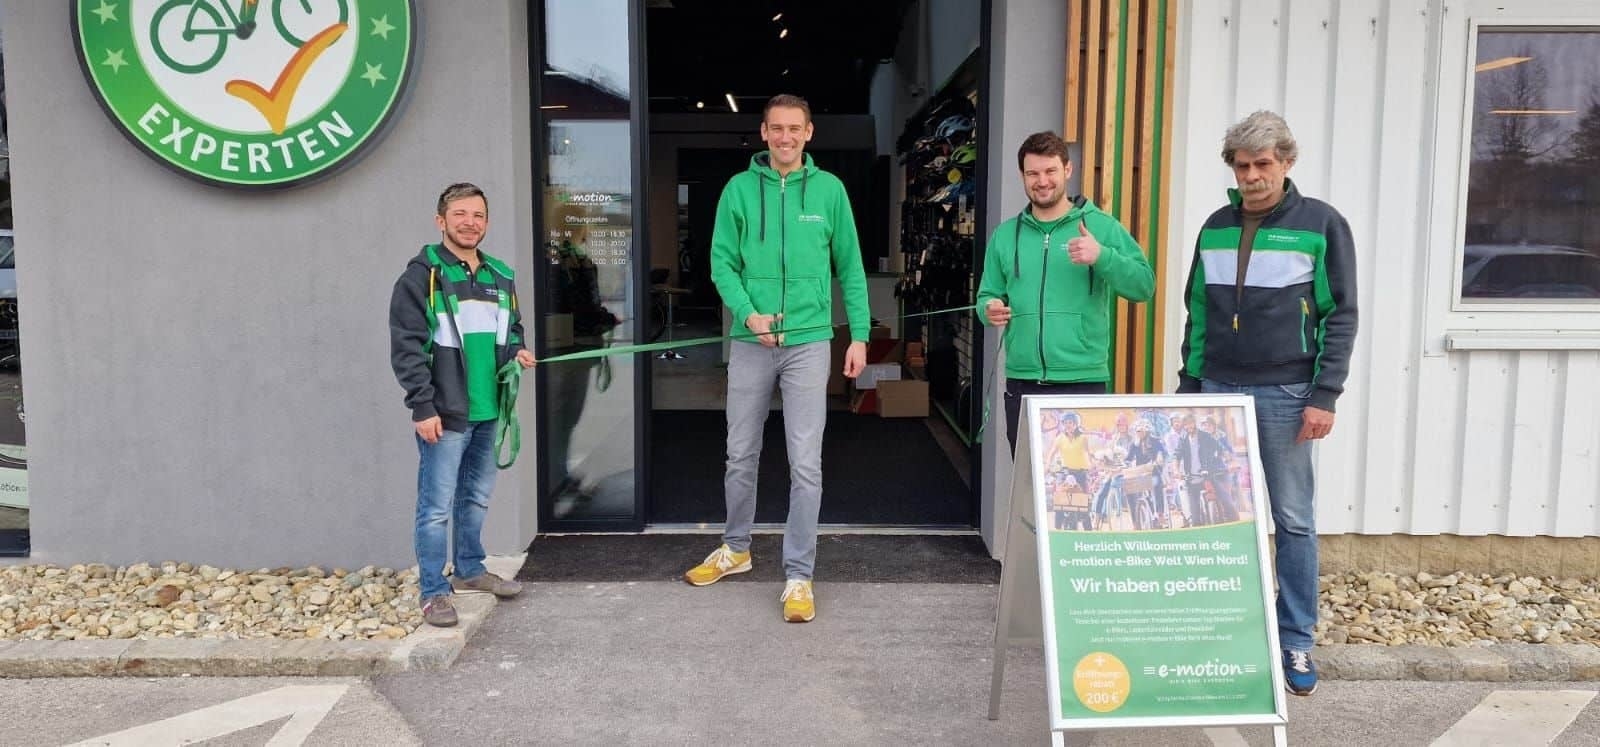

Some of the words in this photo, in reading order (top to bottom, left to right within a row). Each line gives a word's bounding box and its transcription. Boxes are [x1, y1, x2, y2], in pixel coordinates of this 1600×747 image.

[137, 102, 354, 173] EXPERTEN
[1074, 541, 1122, 552] Herzlich
[1124, 540, 1197, 552] Willkommen
[1199, 540, 1210, 551] in
[1212, 540, 1231, 551] der
[1059, 556, 1112, 567] e-motion
[1114, 556, 1152, 566] e-Bike
[1154, 555, 1182, 566] Welt
[1184, 555, 1215, 566] Wien
[1217, 554, 1248, 565] Nord!
[1070, 578, 1101, 593] Wir
[1106, 577, 1160, 593] haben
[1164, 576, 1242, 596] geöffnet!
[1158, 658, 1243, 678] e-motion
[1087, 692, 1109, 704] 200
